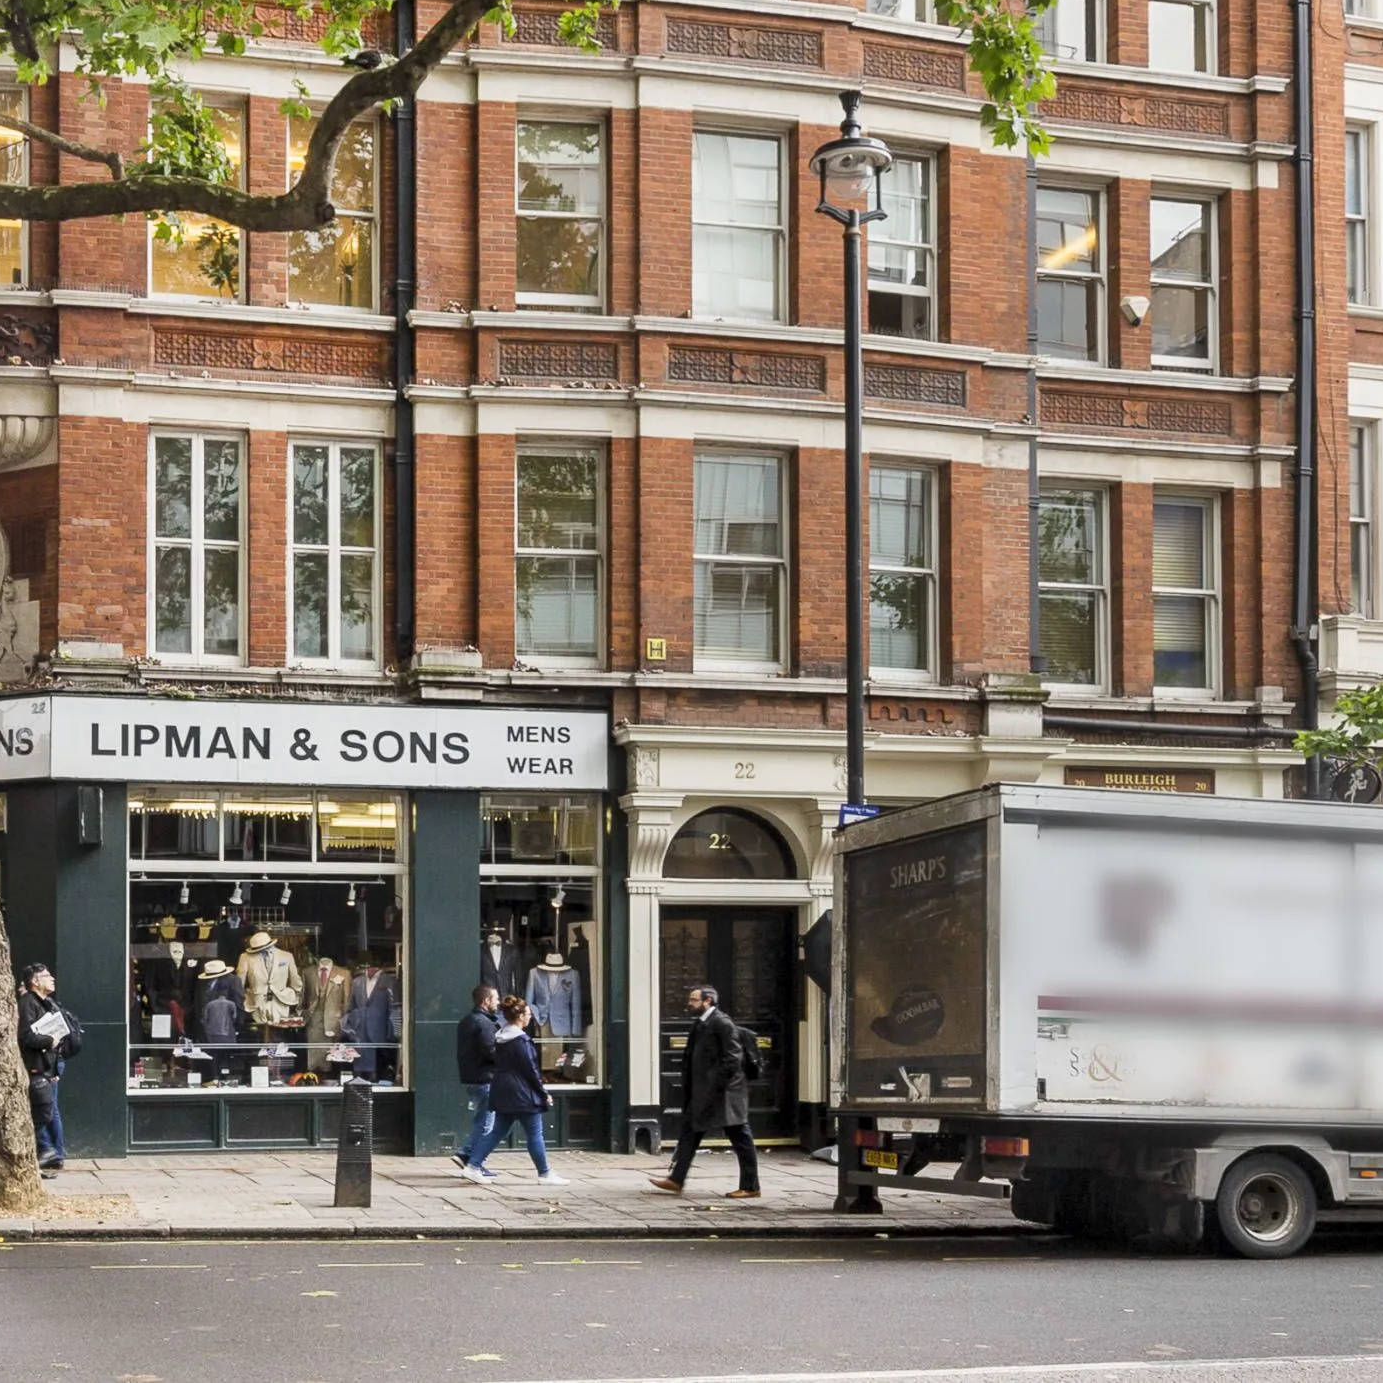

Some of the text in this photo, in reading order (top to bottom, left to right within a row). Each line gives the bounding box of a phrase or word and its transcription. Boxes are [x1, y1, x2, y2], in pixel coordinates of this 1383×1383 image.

[91, 723, 471, 765] LIPMAN & SONS
[507, 725, 571, 744] MENS
[507, 757, 574, 776] WEAR
[735, 762, 755, 779] 22
[1105, 773, 1176, 786] BURLEIGH
[1195, 782, 1207, 791] 20
[709, 833, 731, 849] 22
[890, 856, 946, 888] SHARP'S
